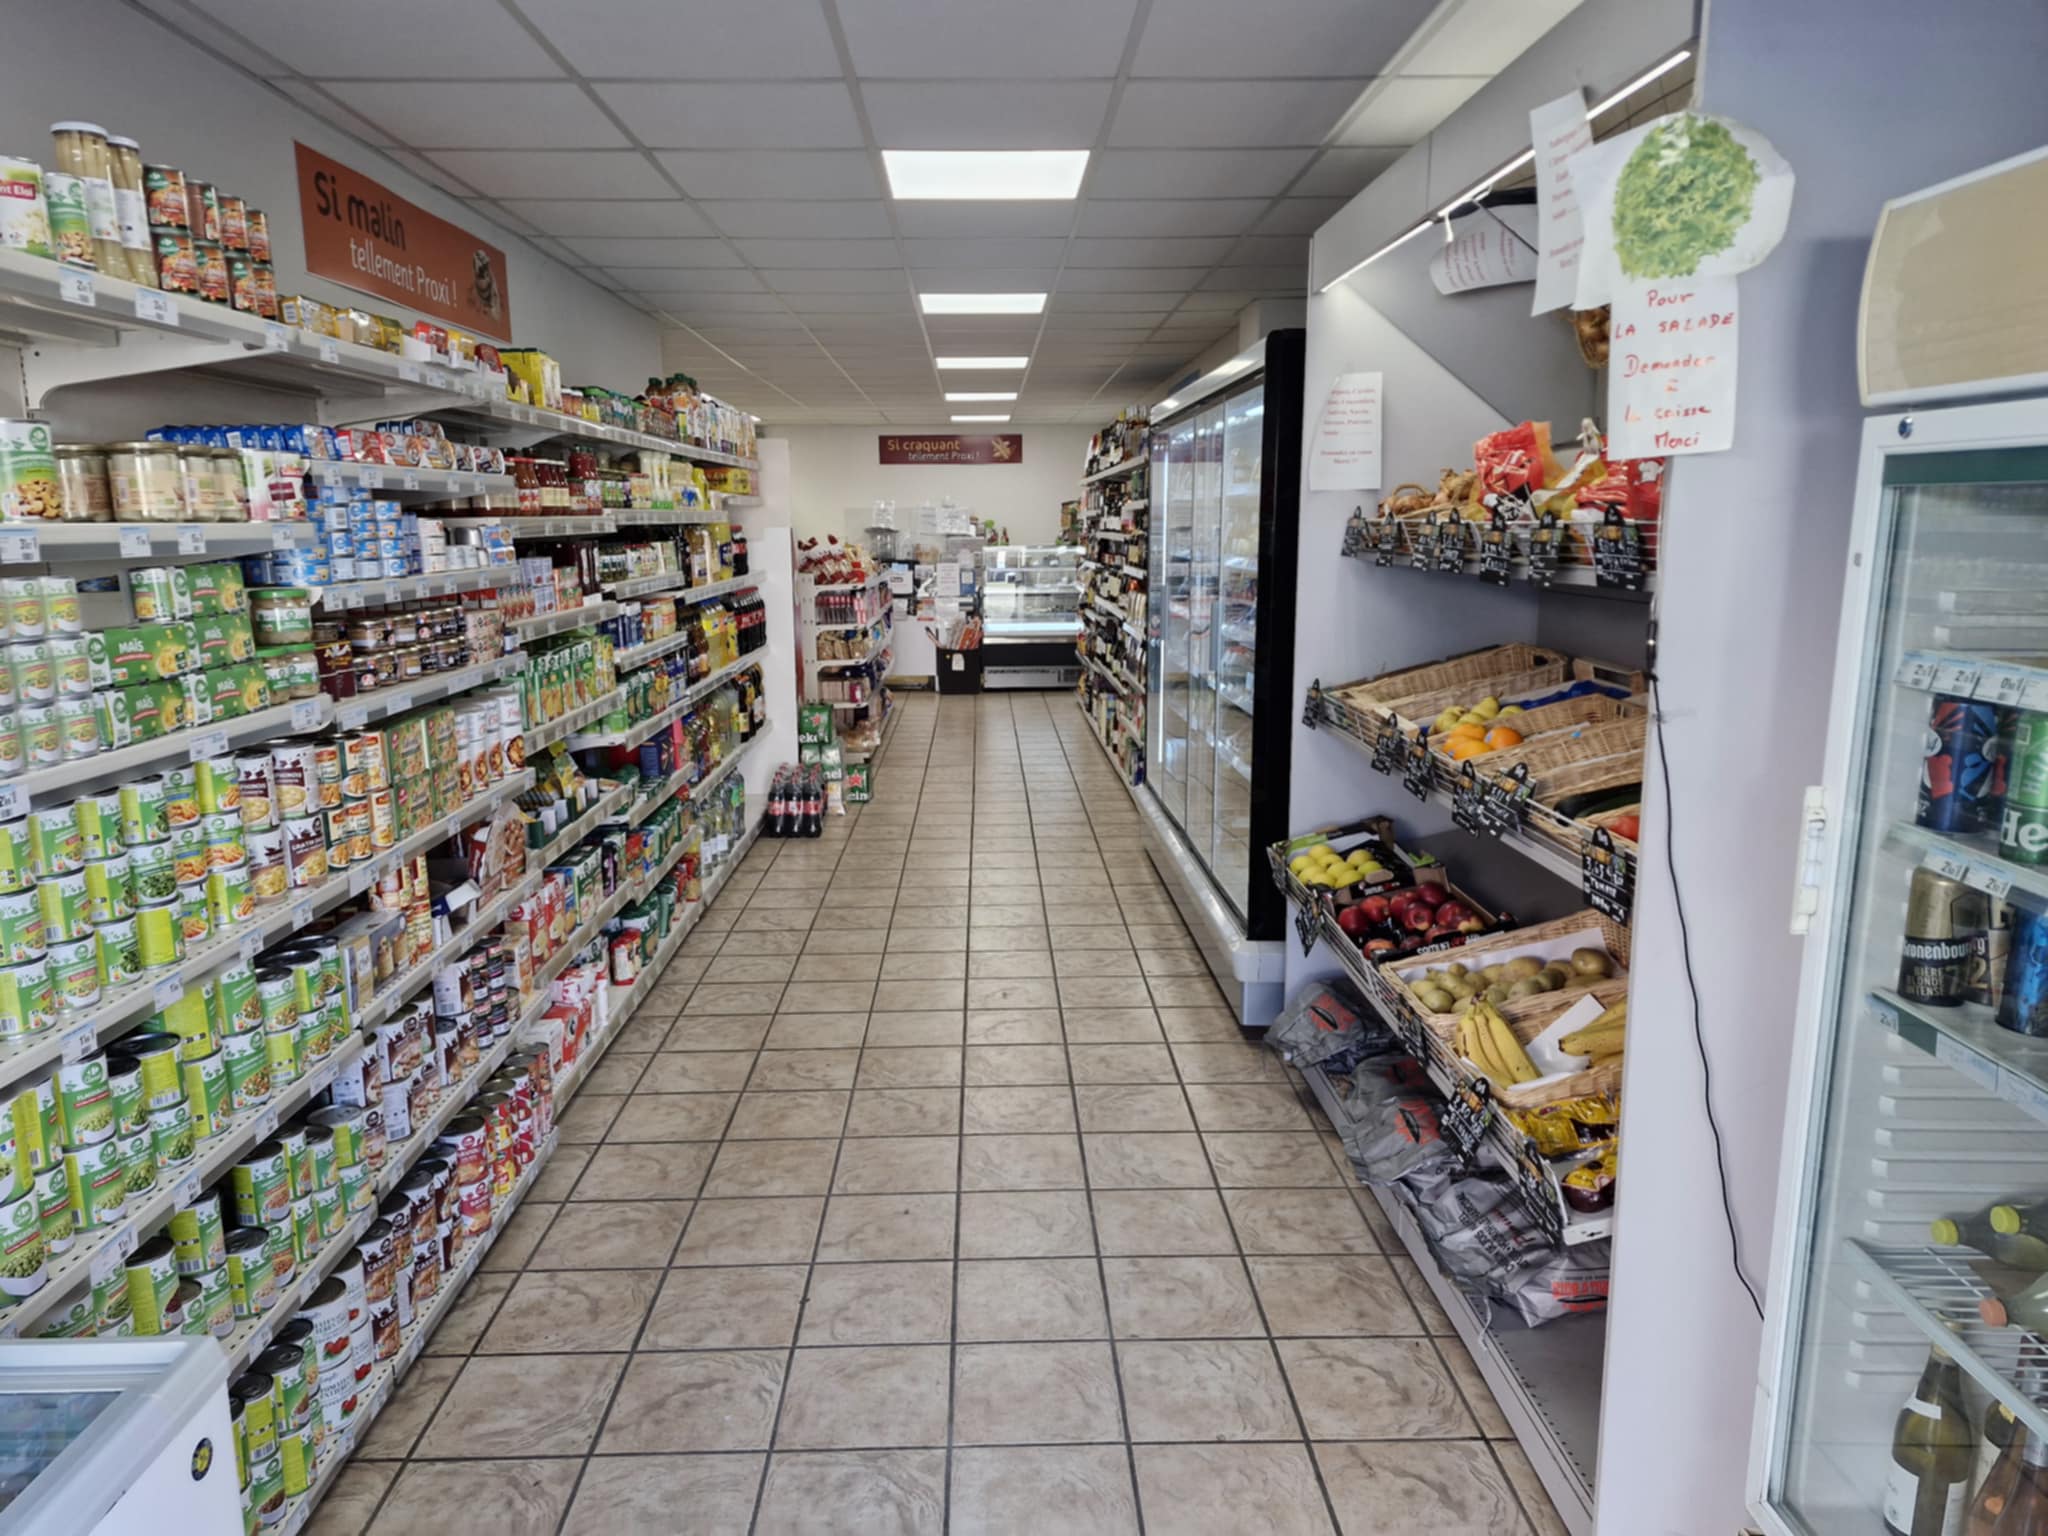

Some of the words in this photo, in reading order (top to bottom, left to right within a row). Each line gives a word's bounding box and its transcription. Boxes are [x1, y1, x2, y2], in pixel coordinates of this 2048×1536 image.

[314, 171, 342, 222] Si
[347, 193, 406, 250] malin
[350, 237, 414, 292] tellement
[416, 265, 450, 305] Proxi
[1646, 288, 1696, 307] Pour
[1615, 323, 1636, 340] LA
[1657, 312, 1735, 334] SALADE
[1623, 353, 1716, 379] Demander
[1654, 404, 1712, 420] caisse
[887, 439, 900, 451] Si
[903, 440, 961, 453] craquant
[1653, 430, 1700, 449] Merci
[907, 451, 949, 461] tellement
